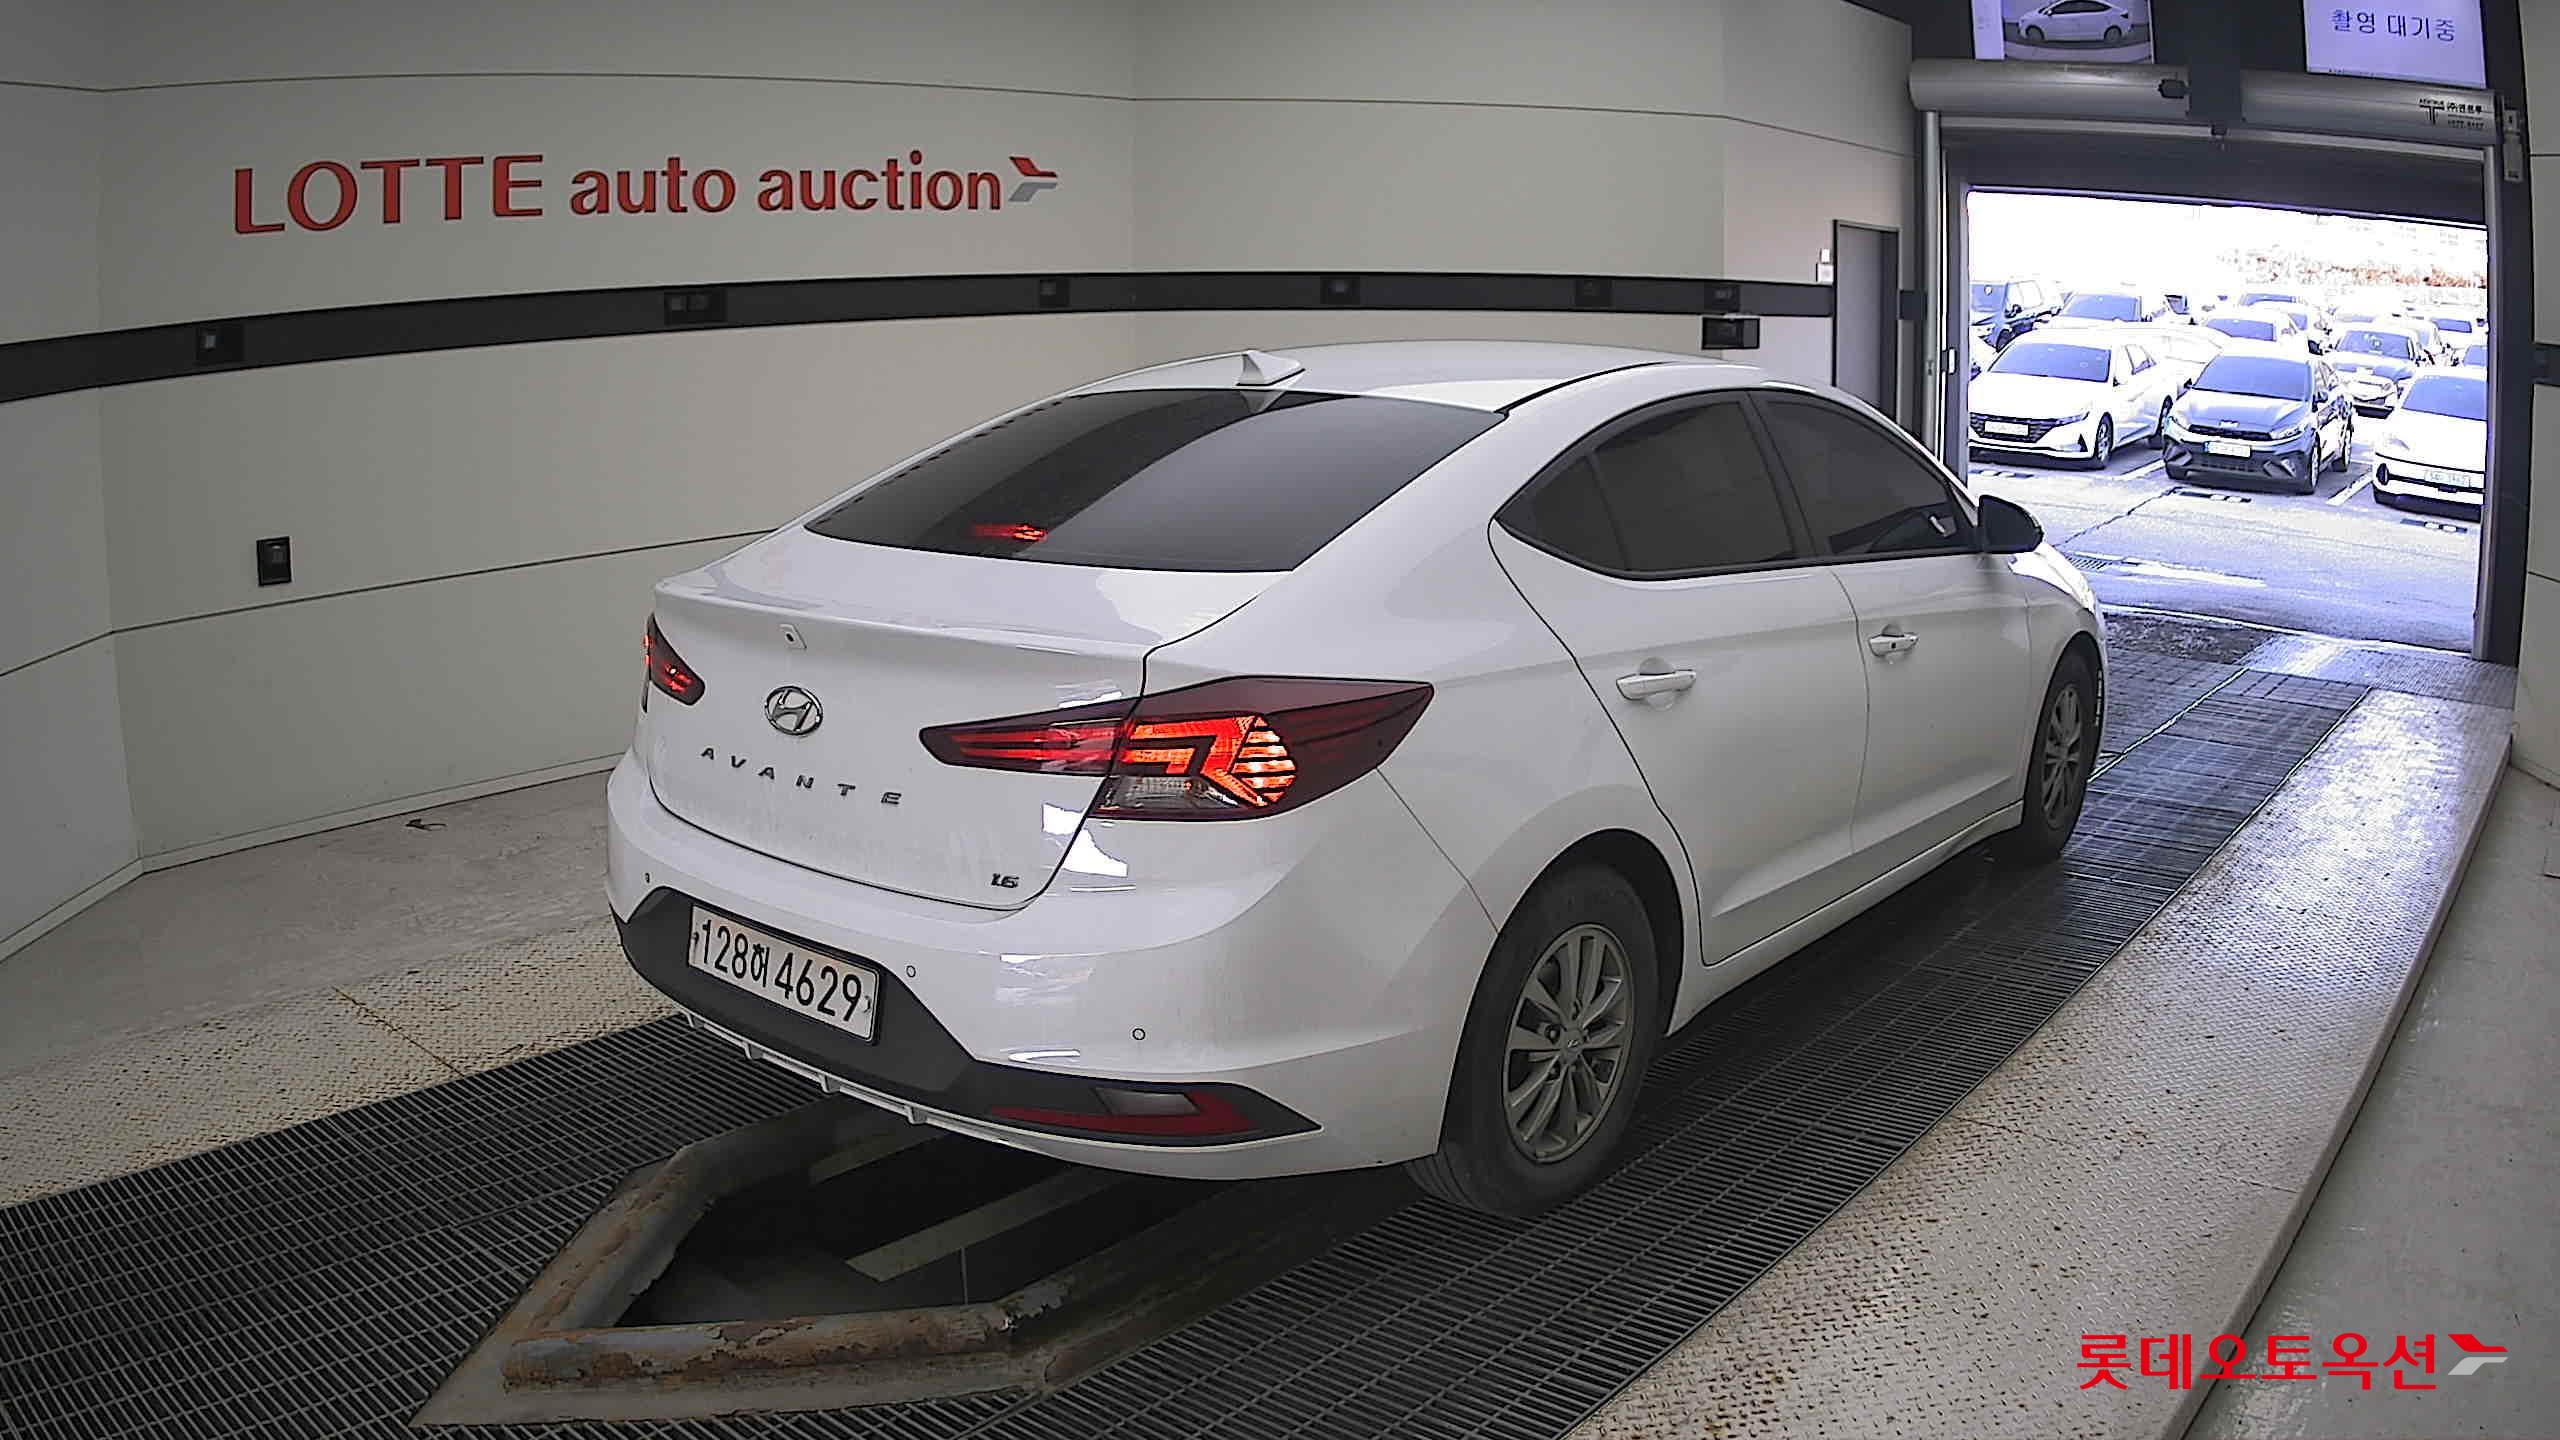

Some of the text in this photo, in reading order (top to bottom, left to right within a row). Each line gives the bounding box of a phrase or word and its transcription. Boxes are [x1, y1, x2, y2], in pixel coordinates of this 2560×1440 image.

[2331, 9, 2376, 34] 촬영
[234, 150, 1001, 234] LOTTE auto auction
[701, 747, 903, 805] AVANTE
[702, 919, 862, 1022] 128허4629
